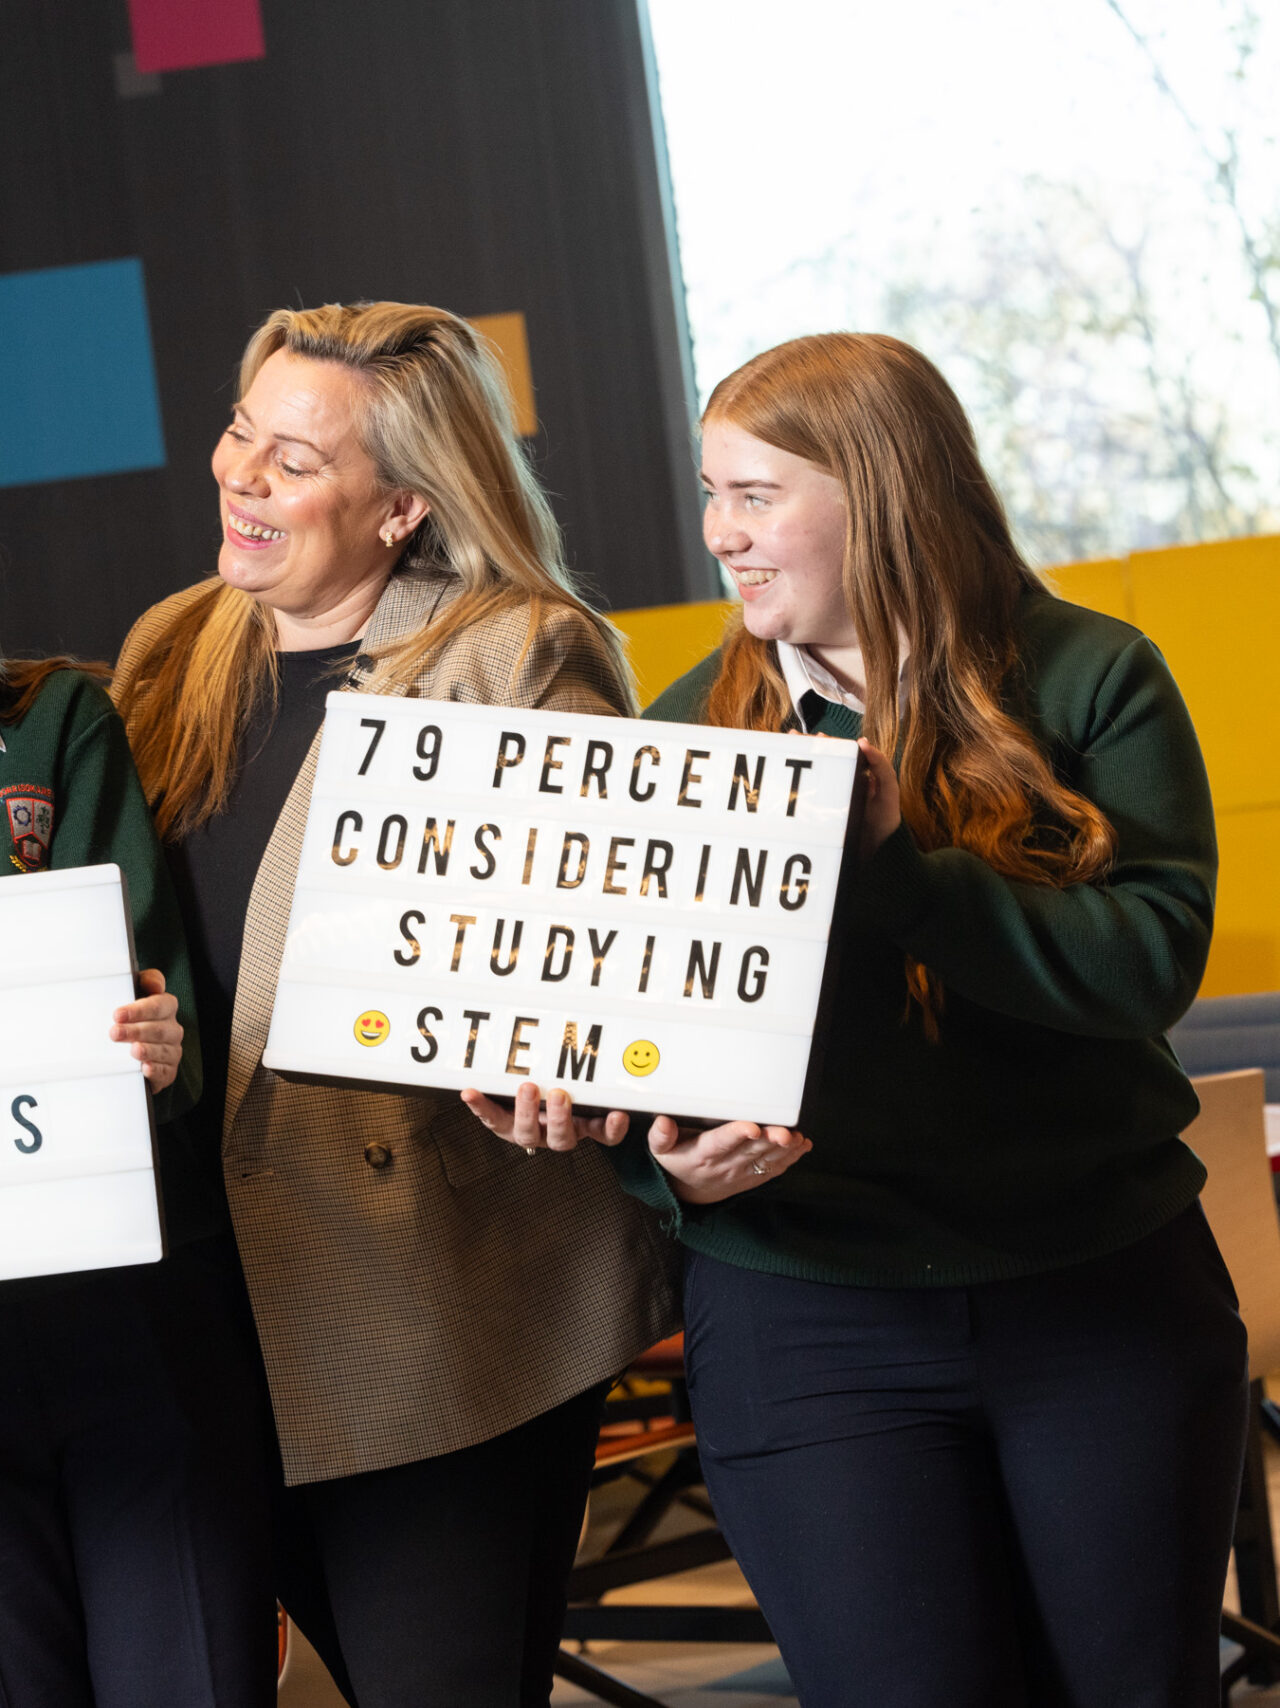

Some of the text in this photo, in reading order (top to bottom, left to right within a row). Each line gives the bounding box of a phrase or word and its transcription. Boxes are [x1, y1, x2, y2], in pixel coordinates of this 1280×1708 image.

[358, 719, 812, 817] 79 PERCENT
[332, 811, 811, 911] CONSIDERING
[394, 910, 769, 1003] STUDYING
[411, 1007, 602, 1082] STEM
